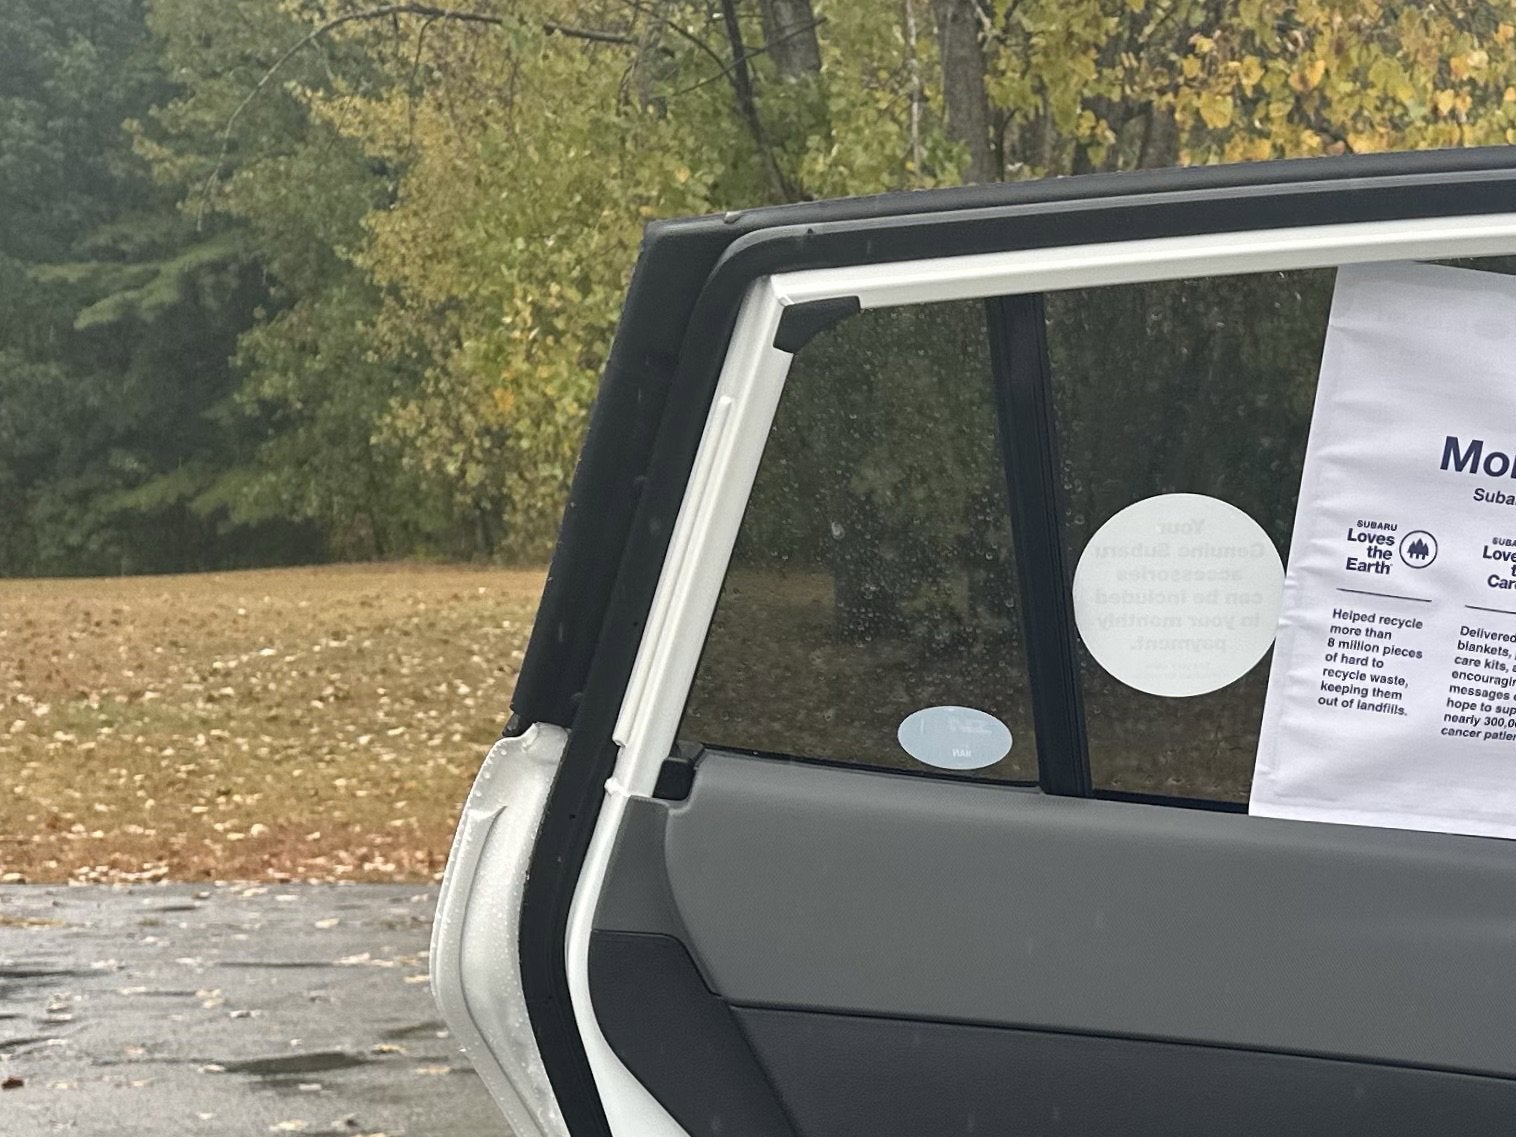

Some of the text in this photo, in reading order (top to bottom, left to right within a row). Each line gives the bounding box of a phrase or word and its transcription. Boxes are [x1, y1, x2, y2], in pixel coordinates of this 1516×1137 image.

[1357, 520, 1398, 532] SUBARU
[1347, 528, 1395, 546] Loves
[1366, 545, 1393, 560] the
[1332, 608, 1423, 630] Helped recycle
[1330, 625, 1392, 641] more than
[1327, 637, 1423, 659] 8 million pieces
[1457, 639, 1512, 660] blankets,
[1325, 652, 1385, 669] of hard to
[1454, 656, 1482, 668] care
[1483, 658, 1509, 674] kits,
[1323, 668, 1409, 689] recycle waste,
[1320, 680, 1403, 701] keeping them
[1449, 684, 1511, 702] messages
[1317, 696, 1408, 716] out of landfills.
[1446, 697, 1477, 712] hope
[1480, 702, 1492, 713] to
[1444, 713, 1482, 728] nearly
[1440, 727, 1482, 738] cancer
